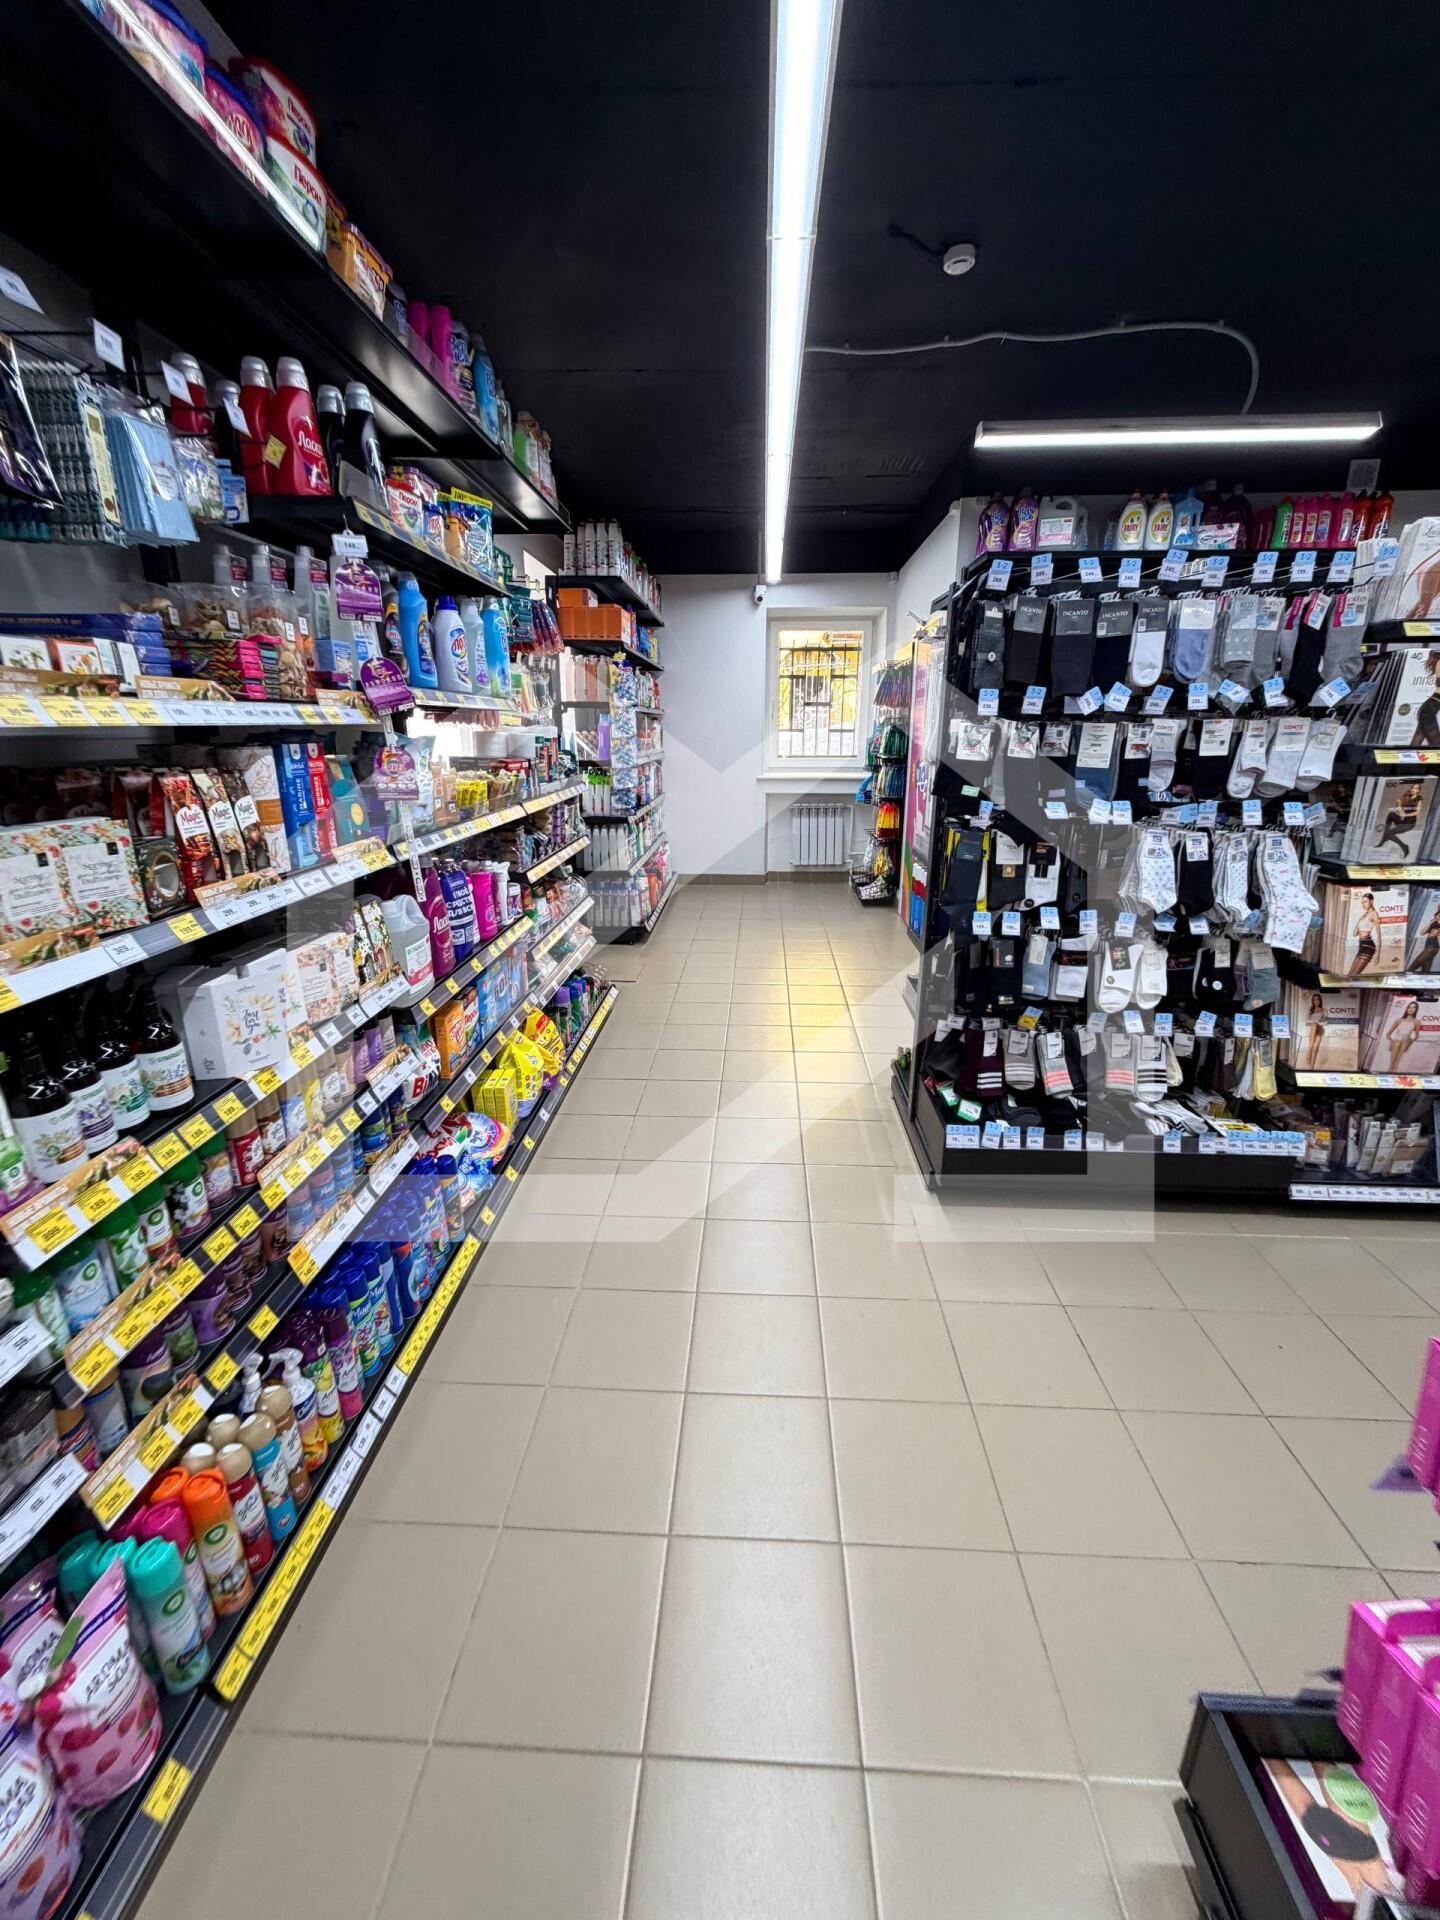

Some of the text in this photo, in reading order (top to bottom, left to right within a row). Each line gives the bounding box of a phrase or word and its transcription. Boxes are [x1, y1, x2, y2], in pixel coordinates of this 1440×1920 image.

[1020, 606, 1043, 614] INCANTO
[1062, 609, 1089, 617] INCANTO
[1102, 610, 1128, 619] INCANTO
[1380, 904, 1404, 912] CONTE
